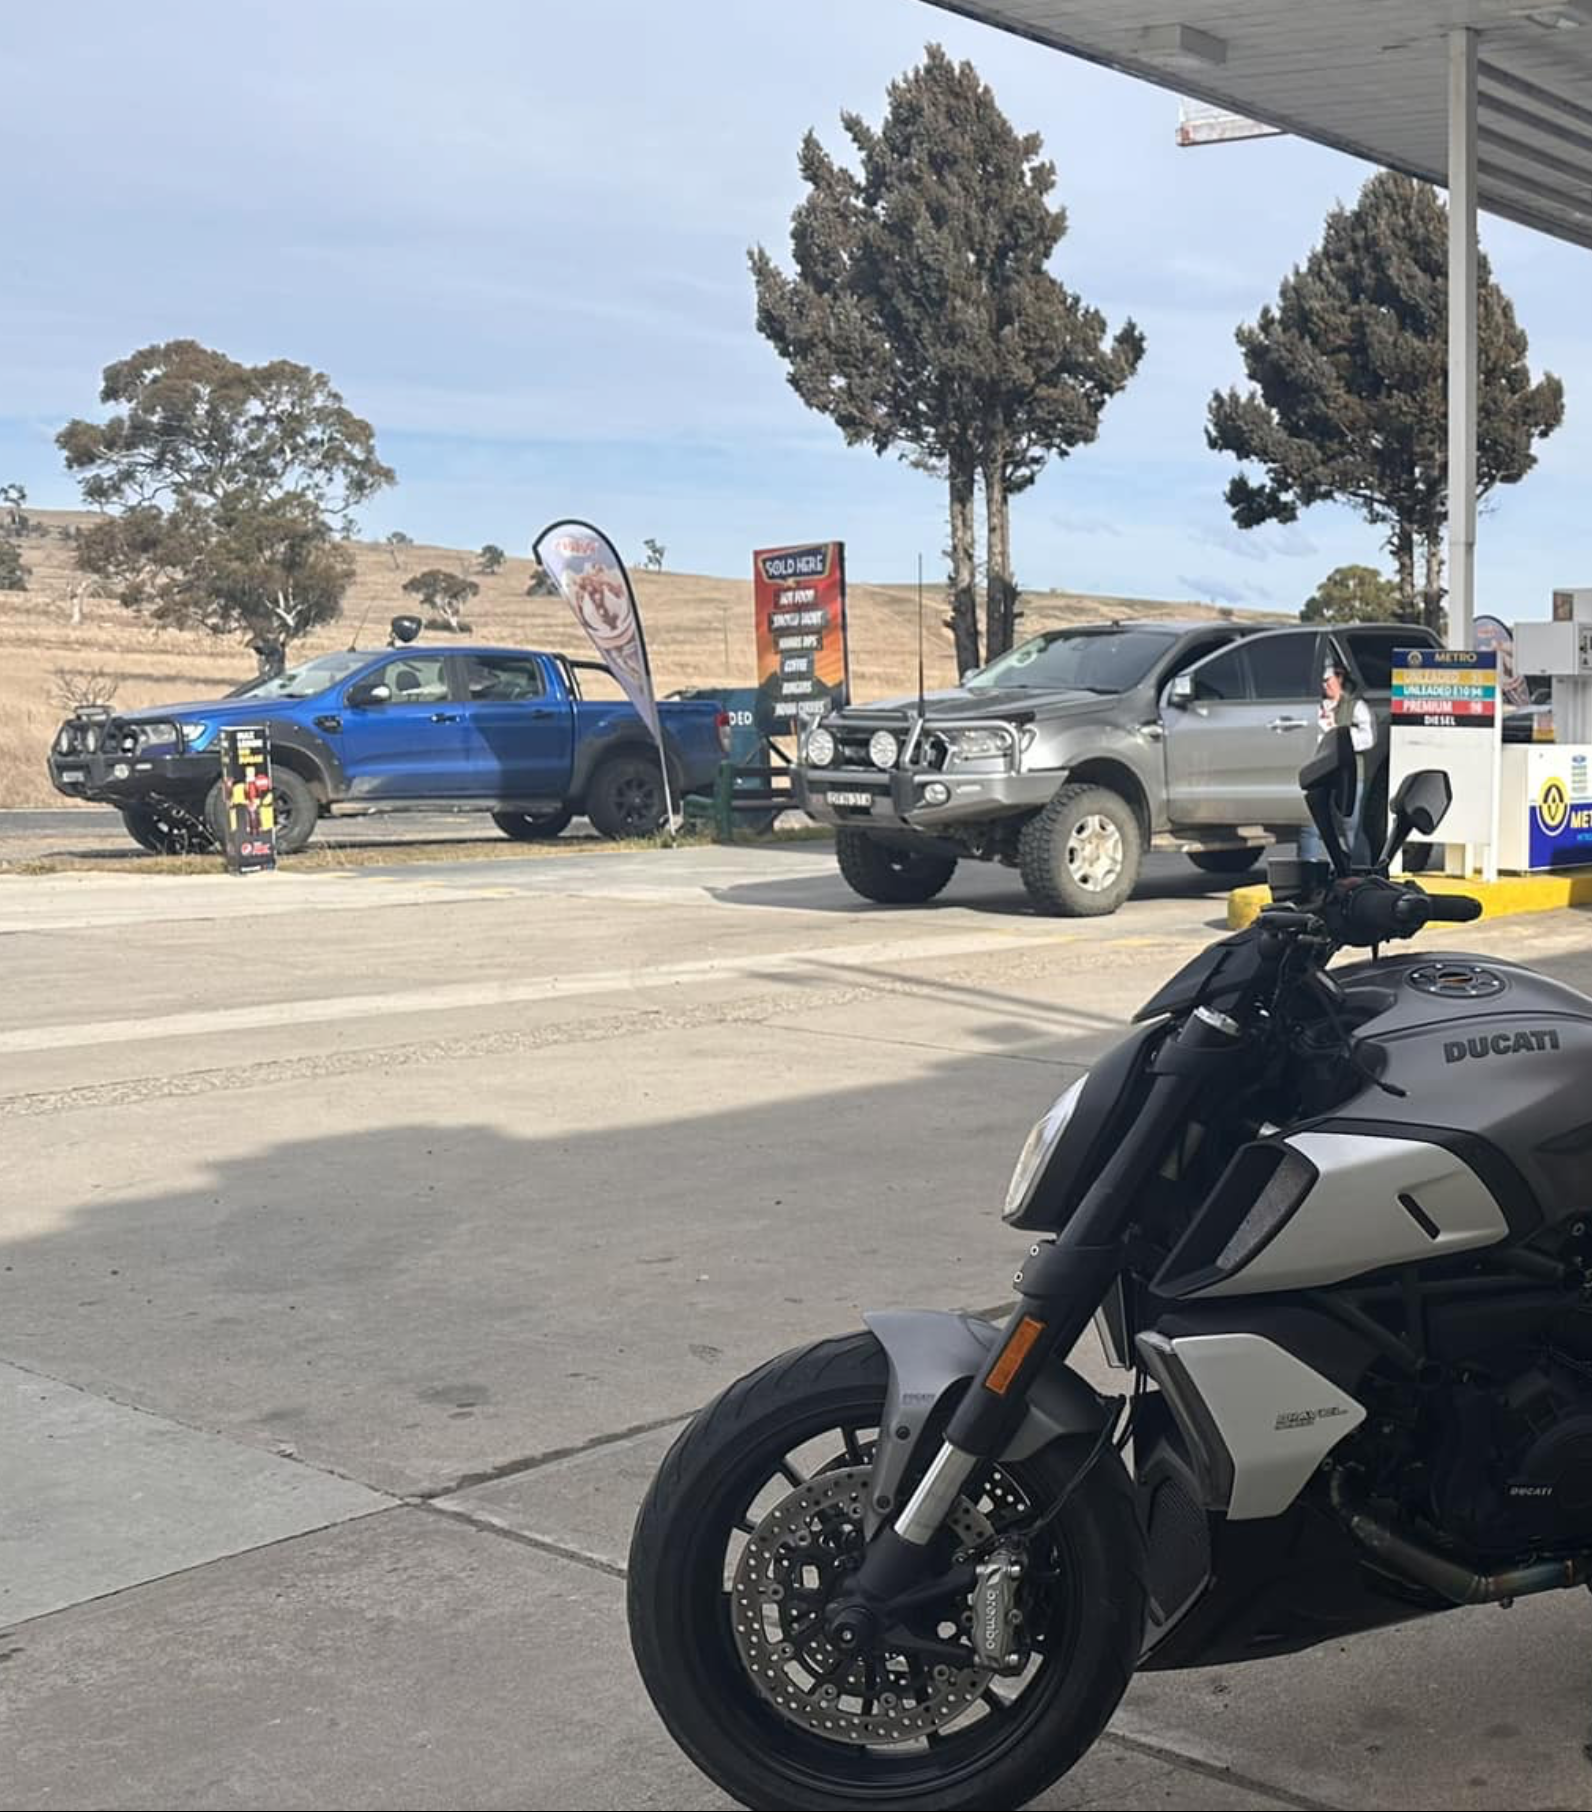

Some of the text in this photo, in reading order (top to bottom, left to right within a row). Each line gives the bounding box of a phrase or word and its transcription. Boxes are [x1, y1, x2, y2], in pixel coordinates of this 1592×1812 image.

[765, 554, 823, 576] SOLD HERE
[1433, 652, 1478, 663] METRO
[1403, 686, 1452, 697] UNLEADED
[1403, 700, 1453, 714] PREMIUM
[728, 711, 753, 726] DED
[1424, 715, 1456, 726] DIESEL
[1442, 1028, 1561, 1064] DUCATI
[1508, 1486, 1554, 1497] DUCATI
[985, 1589, 1000, 1651] brembo
